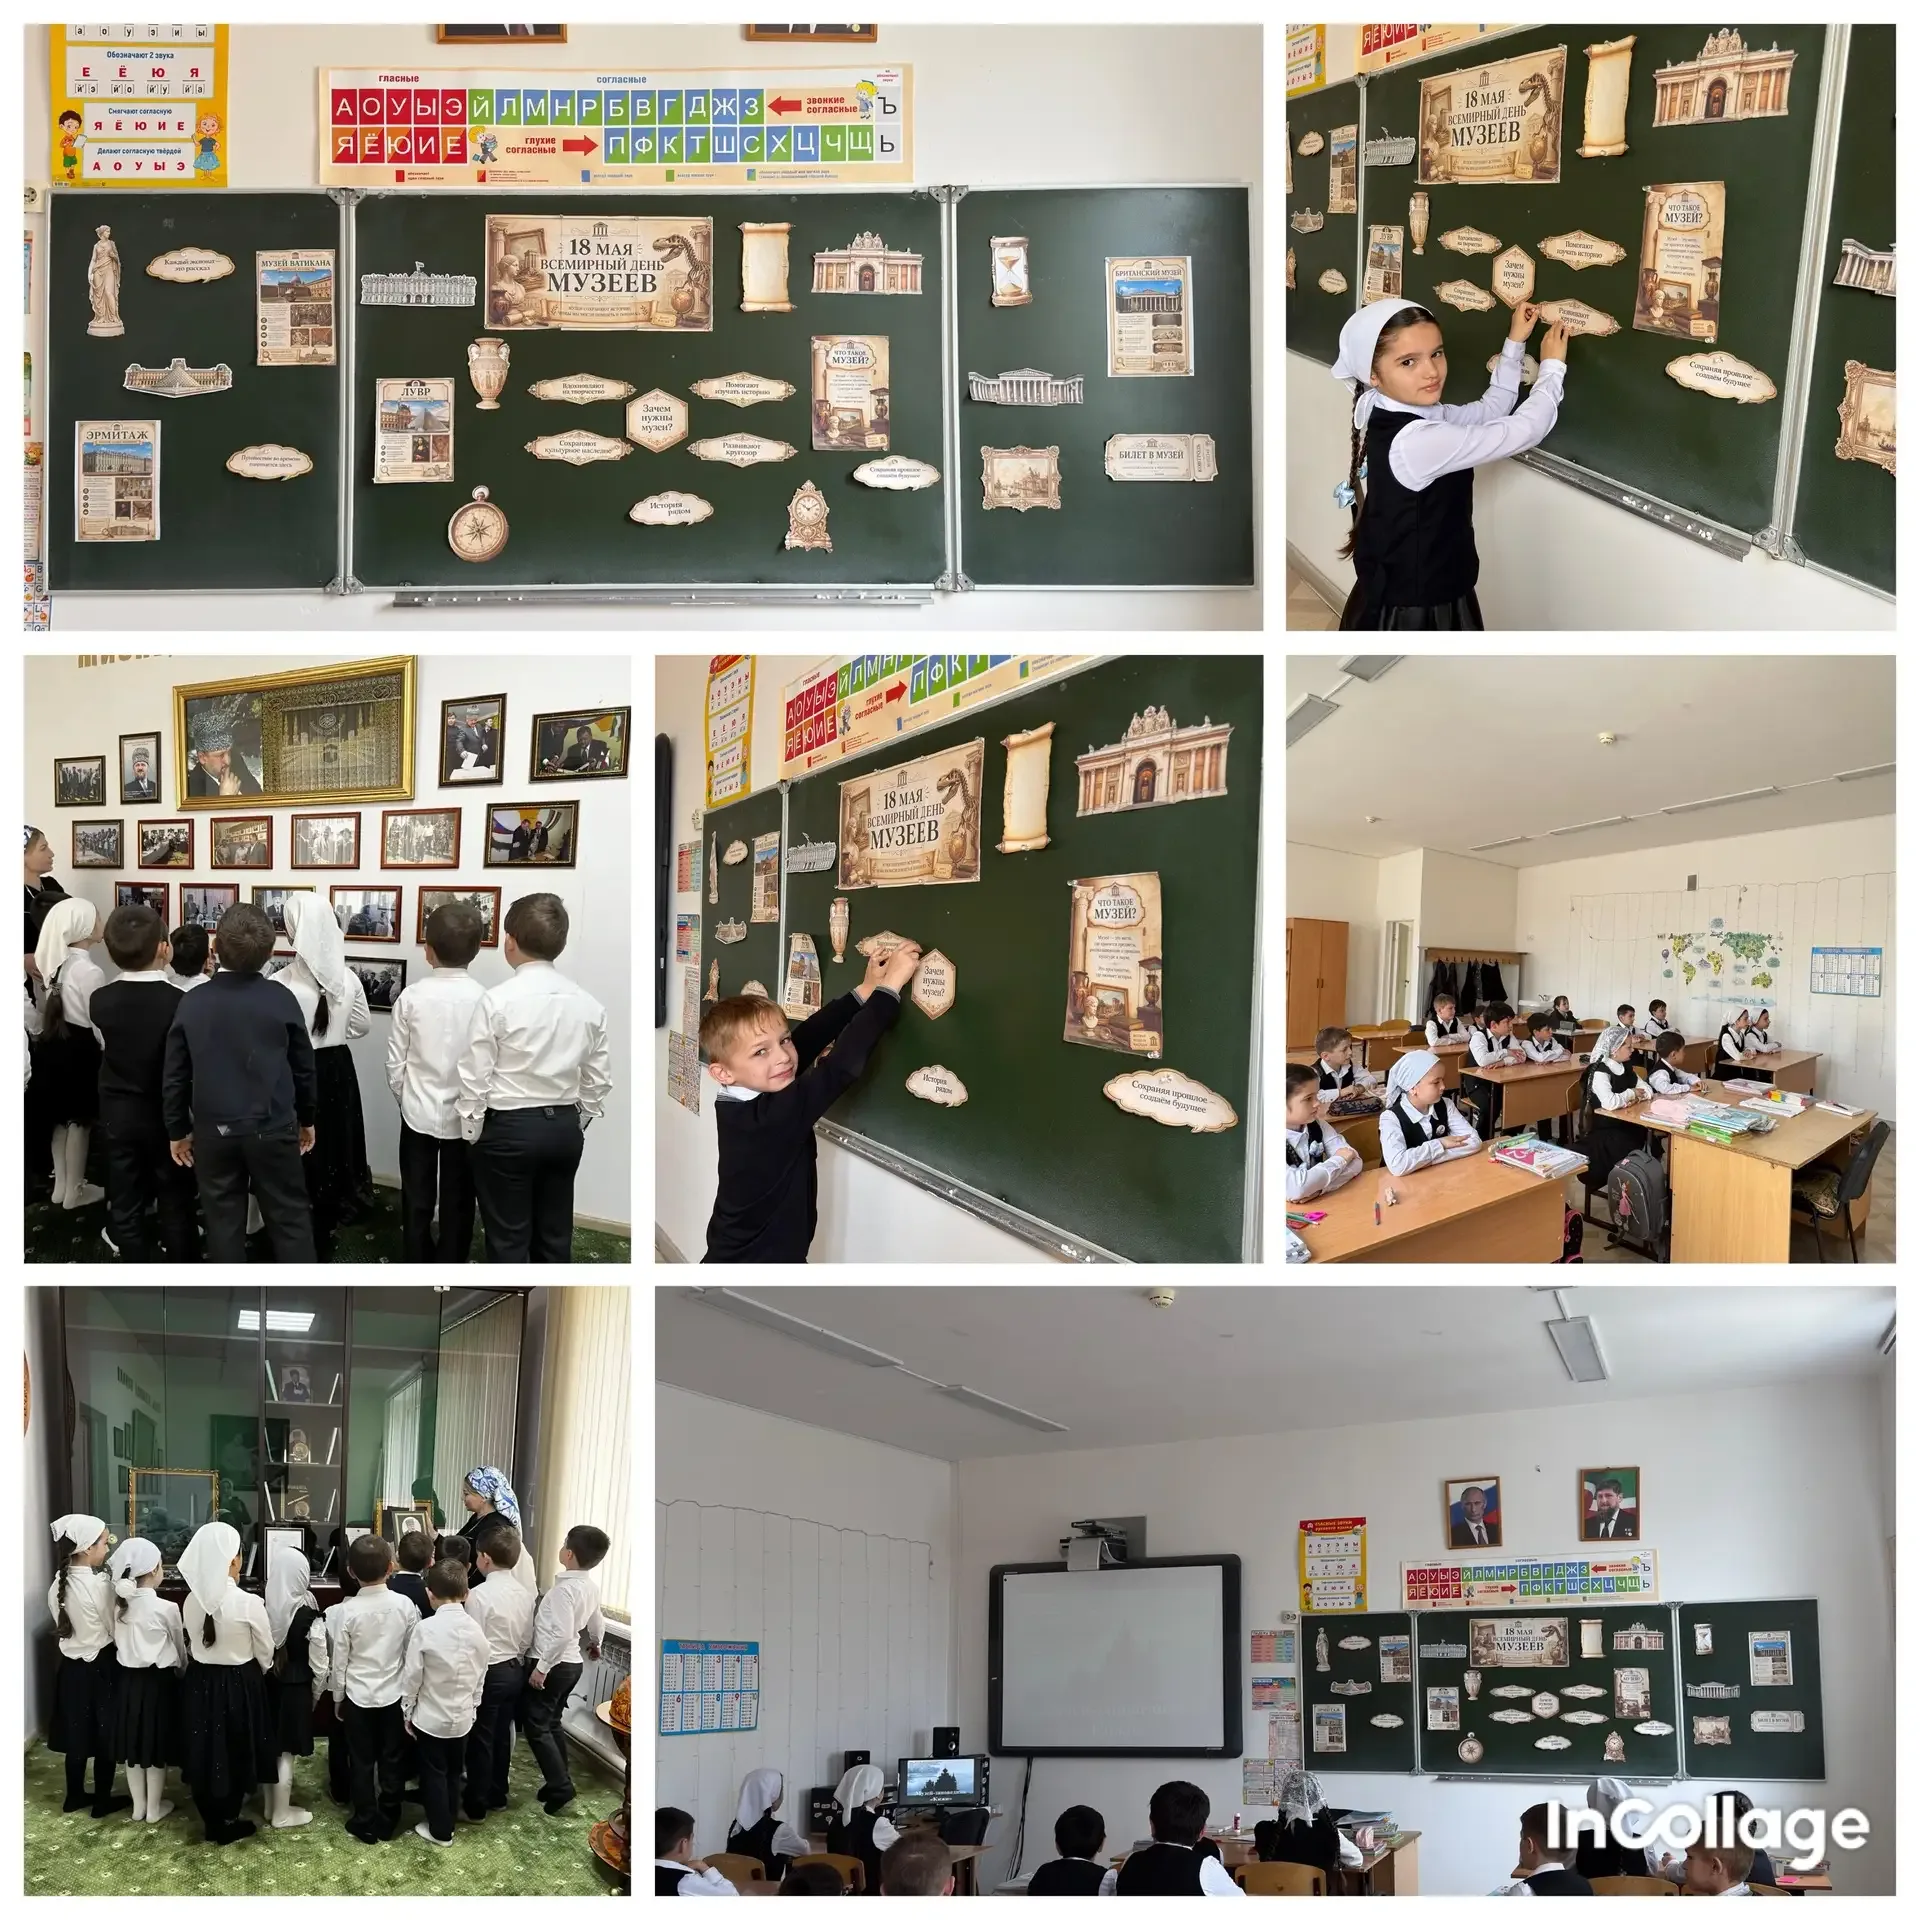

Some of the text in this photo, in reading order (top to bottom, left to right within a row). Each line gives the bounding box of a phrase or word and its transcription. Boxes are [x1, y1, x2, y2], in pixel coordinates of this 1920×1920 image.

[83, 65, 198, 77] Е Ё Ю Я
[378, 74, 420, 84] гласные
[596, 76, 646, 84] согласные
[807, 96, 845, 105] звонкие
[1465, 90, 1504, 108] 18 МАЯ
[807, 104, 858, 114] согласные
[1448, 105, 1527, 126] ВСЕМИРНЫЙ ДЕНЬ
[94, 120, 184, 130] Я Ё Ю И Е
[1451, 121, 1520, 147] МУЗЕЕВ
[526, 136, 556, 146] глухие
[506, 145, 556, 154] согласные
[93, 162, 185, 170] А О У Ы Э
[1668, 204, 1700, 212] ЧТО ТАКОЕ
[1665, 212, 1702, 223] МУЗЕЙ?
[570, 239, 632, 256] 18 МАЯ
[1566, 241, 1593, 250] Помогают
[541, 258, 665, 272] ВСЕМИРНЫЙ ДЕНЬ
[1505, 260, 1524, 270] Зачем
[1116, 270, 1160, 278] БРИТАНСКИЙ
[1504, 270, 1524, 280] нужны
[547, 272, 658, 292] МУЗЕЕВ
[1503, 280, 1524, 289] музеи?
[832, 356, 870, 364] МУЗЕЙ?
[1690, 361, 1753, 381] Сохраняя прошлое
[1696, 371, 1751, 388] создаём будущее
[401, 388, 431, 396] ЛУВР
[642, 404, 671, 413] Зачем
[642, 414, 672, 423] нужны
[642, 422, 673, 432] музеи?
[86, 430, 148, 440] ЭРМИТАЖ
[722, 442, 761, 450] Развивают
[726, 448, 757, 456] кругозор
[1119, 450, 1184, 459] БИЛЕТ В МУЗЕЙ
[668, 508, 690, 516] рядом
[884, 788, 923, 810] 18 МАЯ
[868, 803, 945, 828] ВСЕМИРНЫЙ ДЕНЬ
[870, 820, 939, 850] МУЗЕЕВ
[1113, 898, 1134, 906] ТАКОЕ
[1094, 907, 1136, 920] МУЗЕЙ?
[925, 966, 944, 976] Зачем
[923, 978, 944, 986] нужны
[922, 988, 944, 998] музеи?
[924, 1074, 947, 1085] История
[936, 1086, 952, 1095] рядом
[1132, 1080, 1208, 1104] Сохраняя прошлое
[1140, 1092, 1206, 1113] создаём будущее
[1505, 1628, 1514, 1636] 18
[1496, 1642, 1544, 1651] МУЗЕЕВ
